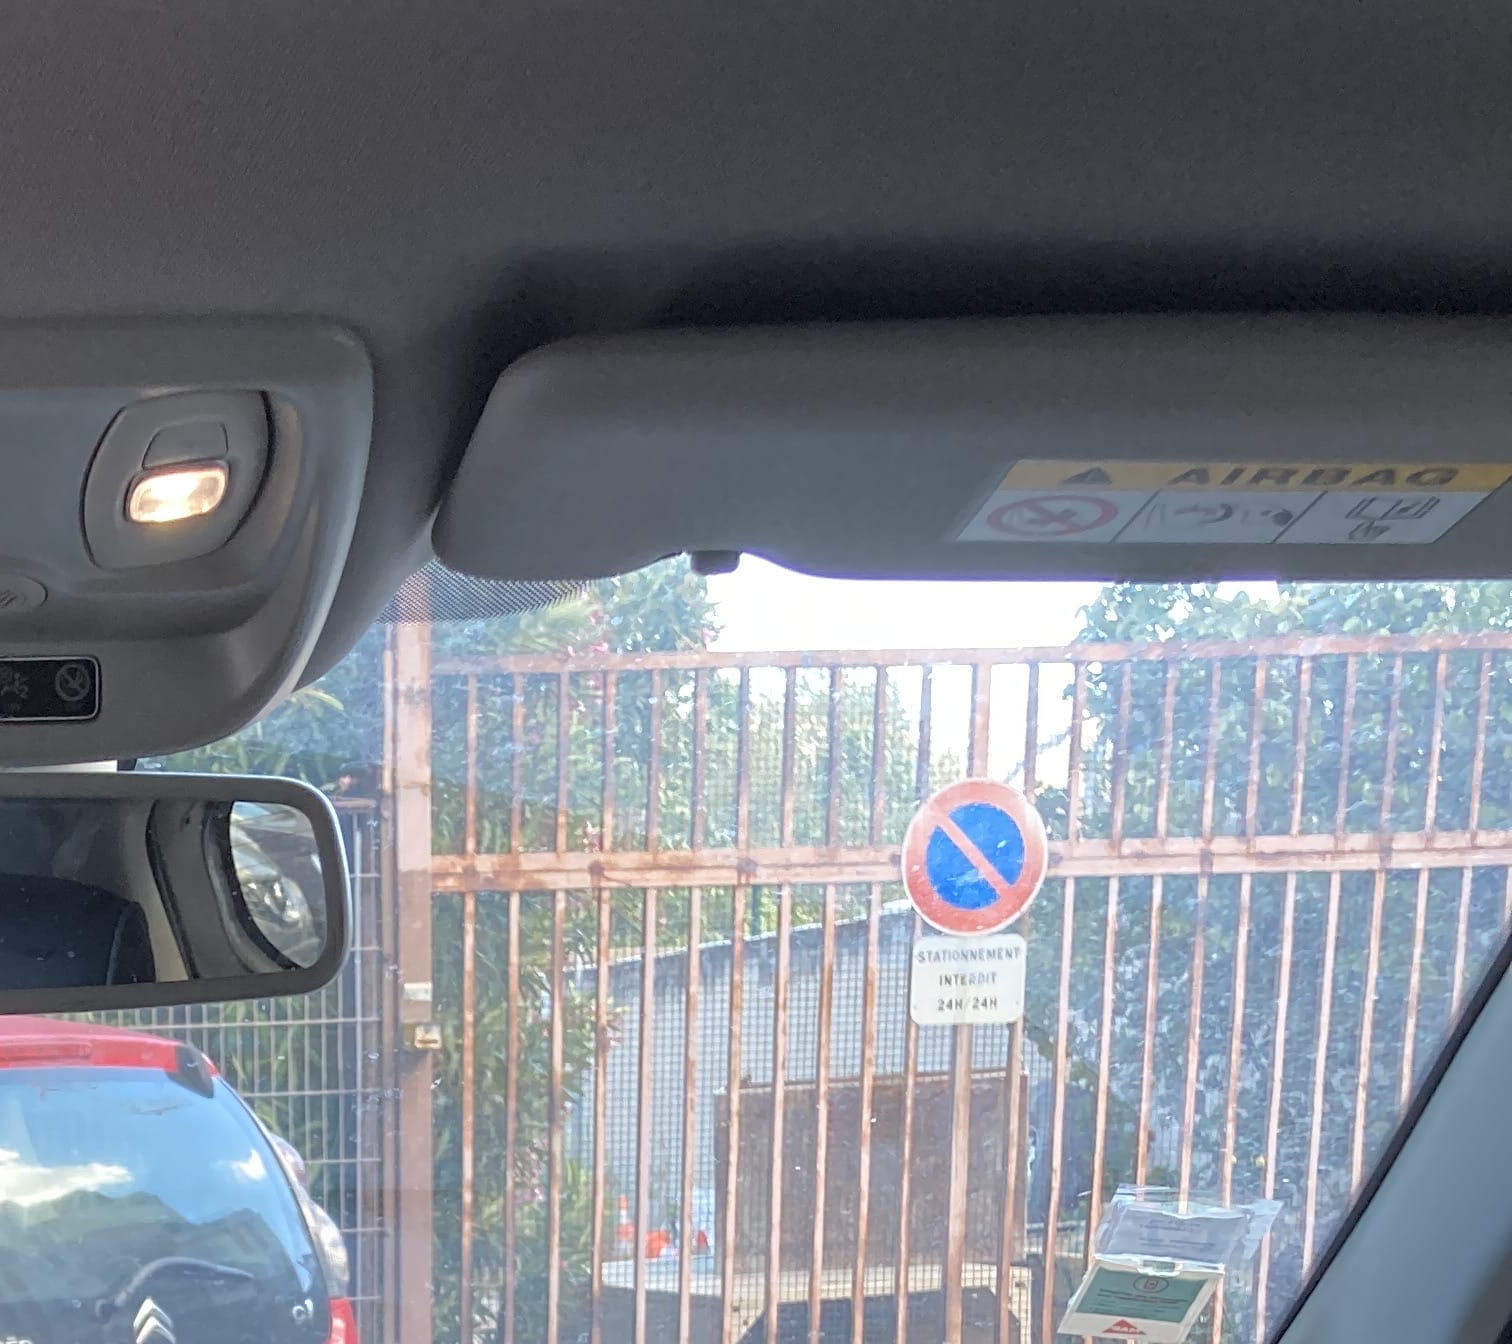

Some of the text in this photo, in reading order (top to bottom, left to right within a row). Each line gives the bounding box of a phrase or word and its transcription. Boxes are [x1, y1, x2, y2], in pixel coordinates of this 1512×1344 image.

[1167, 467, 1459, 486] AIRBAG
[917, 947, 1021, 963] STATIONNEMENT
[939, 972, 997, 986] INTERDIT
